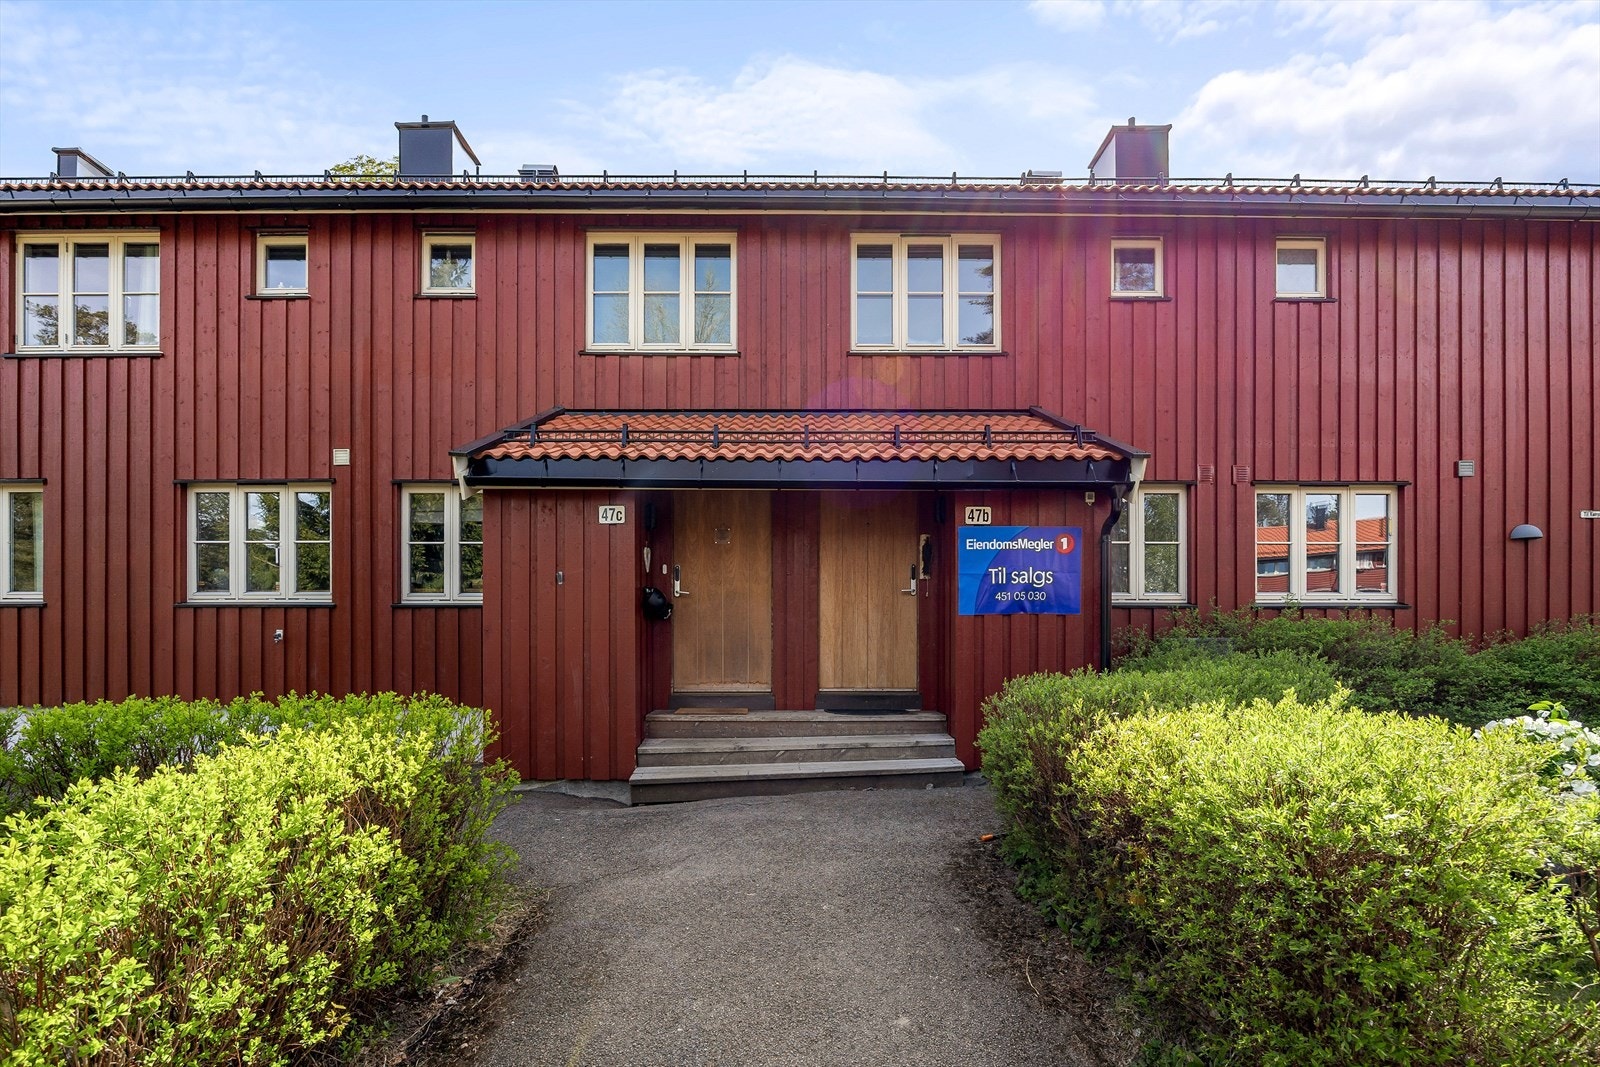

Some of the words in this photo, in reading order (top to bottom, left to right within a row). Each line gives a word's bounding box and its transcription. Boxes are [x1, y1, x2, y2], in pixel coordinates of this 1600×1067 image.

[601, 508, 622, 521] 47c
[967, 509, 989, 522] 47b
[966, 538, 1055, 552] EiendomsMegler
[1060, 537, 1067, 550] 1
[988, 567, 1006, 584] Til
[1011, 567, 1053, 587] salgs
[995, 591, 1011, 601] 451
[1013, 591, 1026, 601] 05
[1027, 591, 1047, 601] 030
